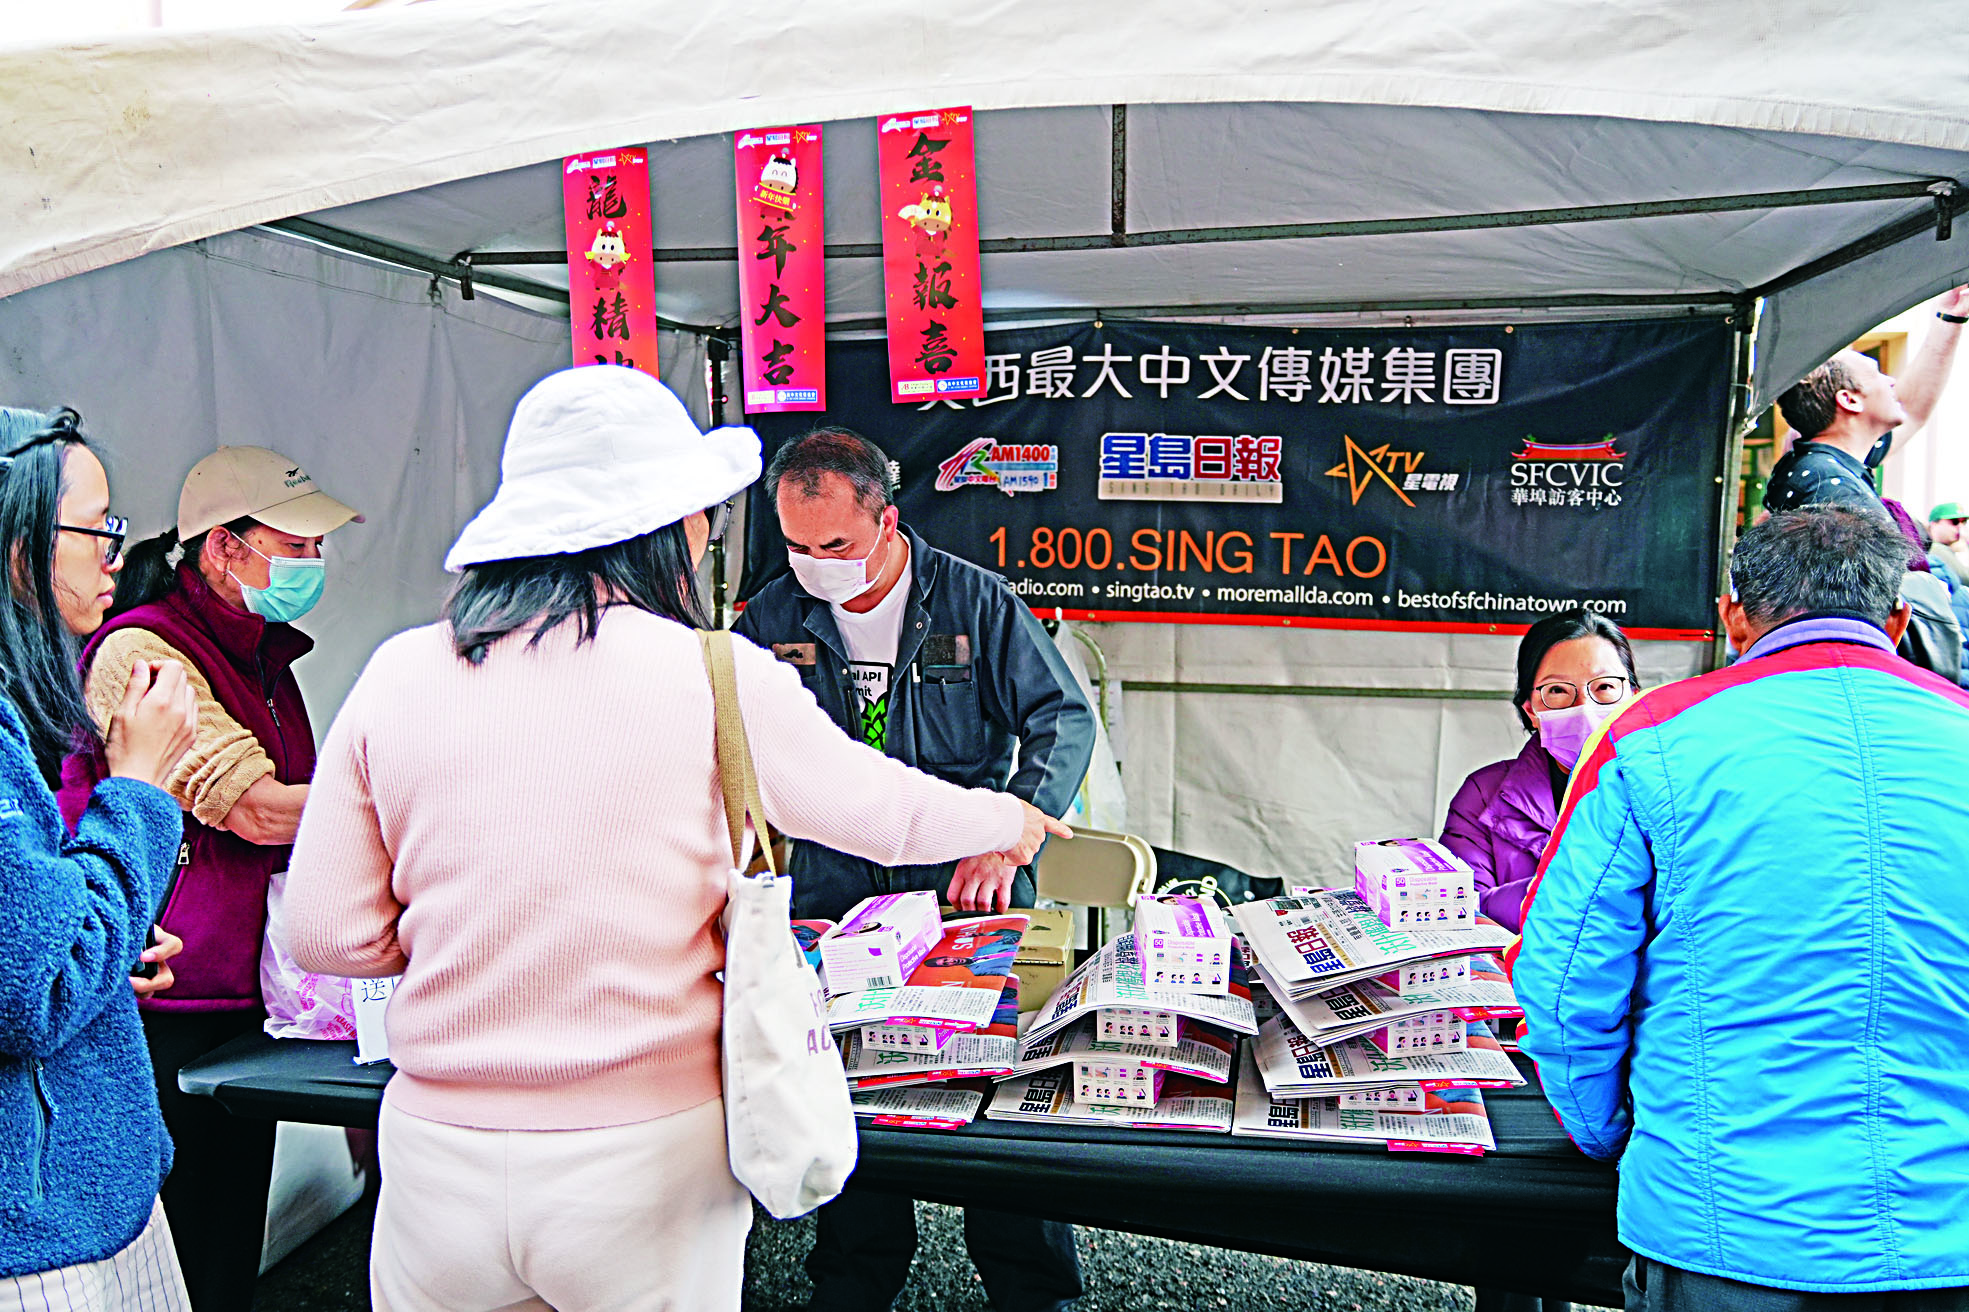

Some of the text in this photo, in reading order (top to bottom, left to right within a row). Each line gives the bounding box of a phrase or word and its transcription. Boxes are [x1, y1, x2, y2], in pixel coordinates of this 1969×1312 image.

[916, 343, 1503, 411] 西最大中文傳媒集團
[991, 446, 1050, 461] AM1400
[1102, 435, 1282, 480] 星島日報
[1402, 473, 1459, 491] 星電視
[1510, 462, 1624, 487] SFCVIC
[1511, 488, 1622, 506] 華埠訪客中心
[989, 526, 1387, 579] 1.800.SING TAO
[1008, 578, 1084, 597] adio.com
[1106, 581, 1195, 602] singtao.tv
[1217, 585, 1374, 606] moremallda.com
[1398, 589, 1627, 614] bestofsfchinatowncom
[862, 671, 882, 682] API
[855, 685, 873, 697] mit
[1286, 925, 1346, 974] 星島日報
[361, 977, 394, 1003] 送
